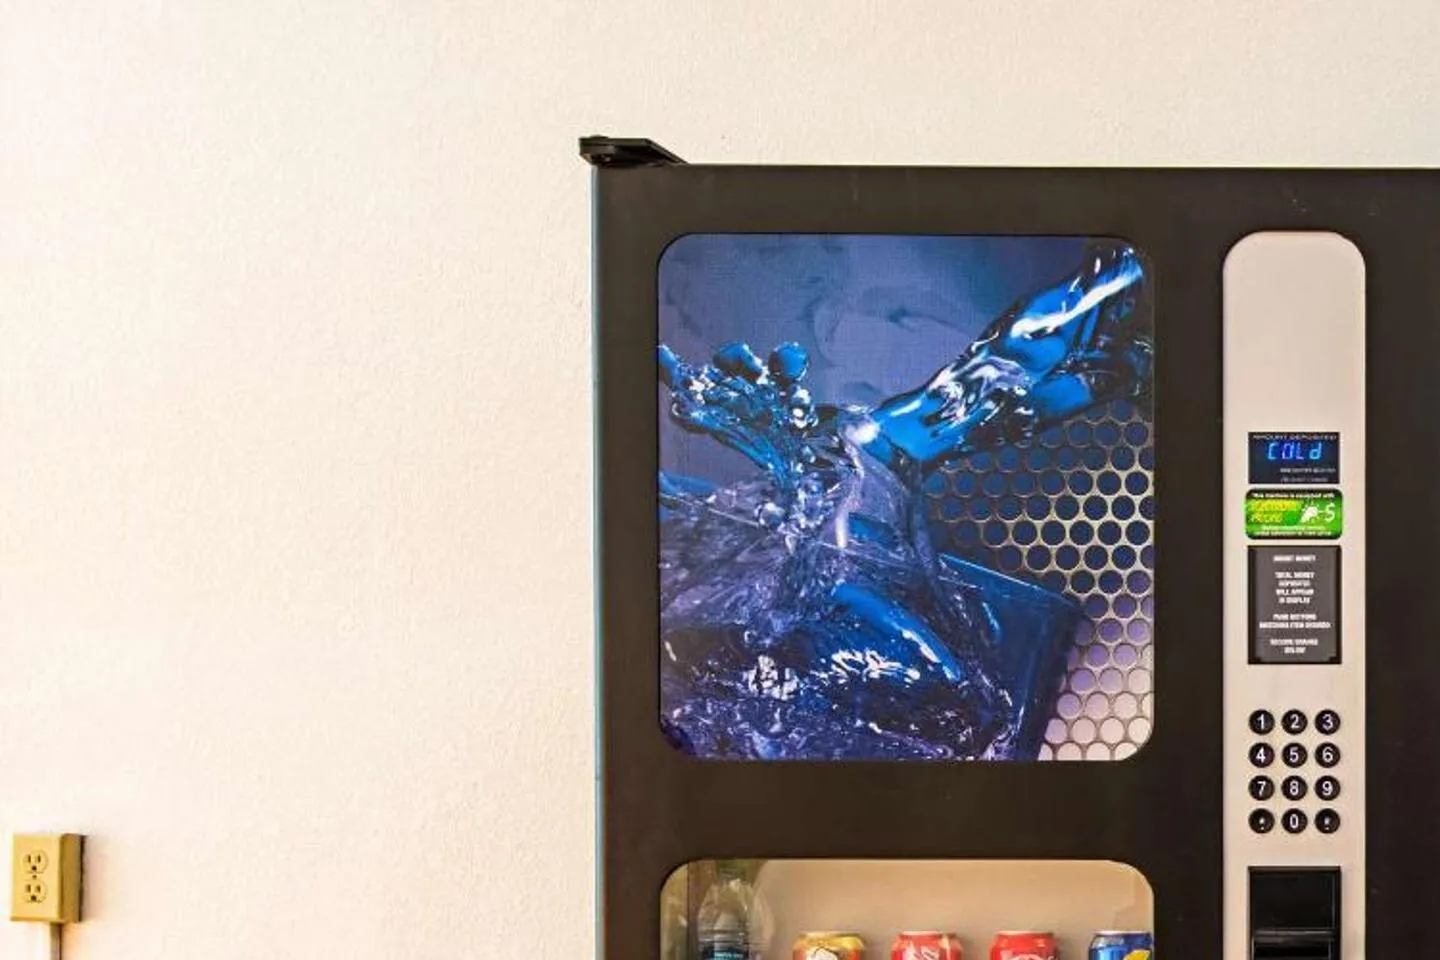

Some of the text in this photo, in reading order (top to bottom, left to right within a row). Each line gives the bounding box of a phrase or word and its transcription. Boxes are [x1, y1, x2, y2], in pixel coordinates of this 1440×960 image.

[1259, 715, 1264, 729] 1
[1291, 714, 1299, 728] 2
[1324, 714, 1333, 730] 3
[1256, 748, 1265, 762] 4
[1290, 748, 1298, 762] 5
[1323, 747, 1333, 762] 6
[1258, 781, 1266, 795] 7
[1290, 781, 1298, 795] 8
[1323, 781, 1332, 795] 9
[1290, 814, 1298, 828] 0
